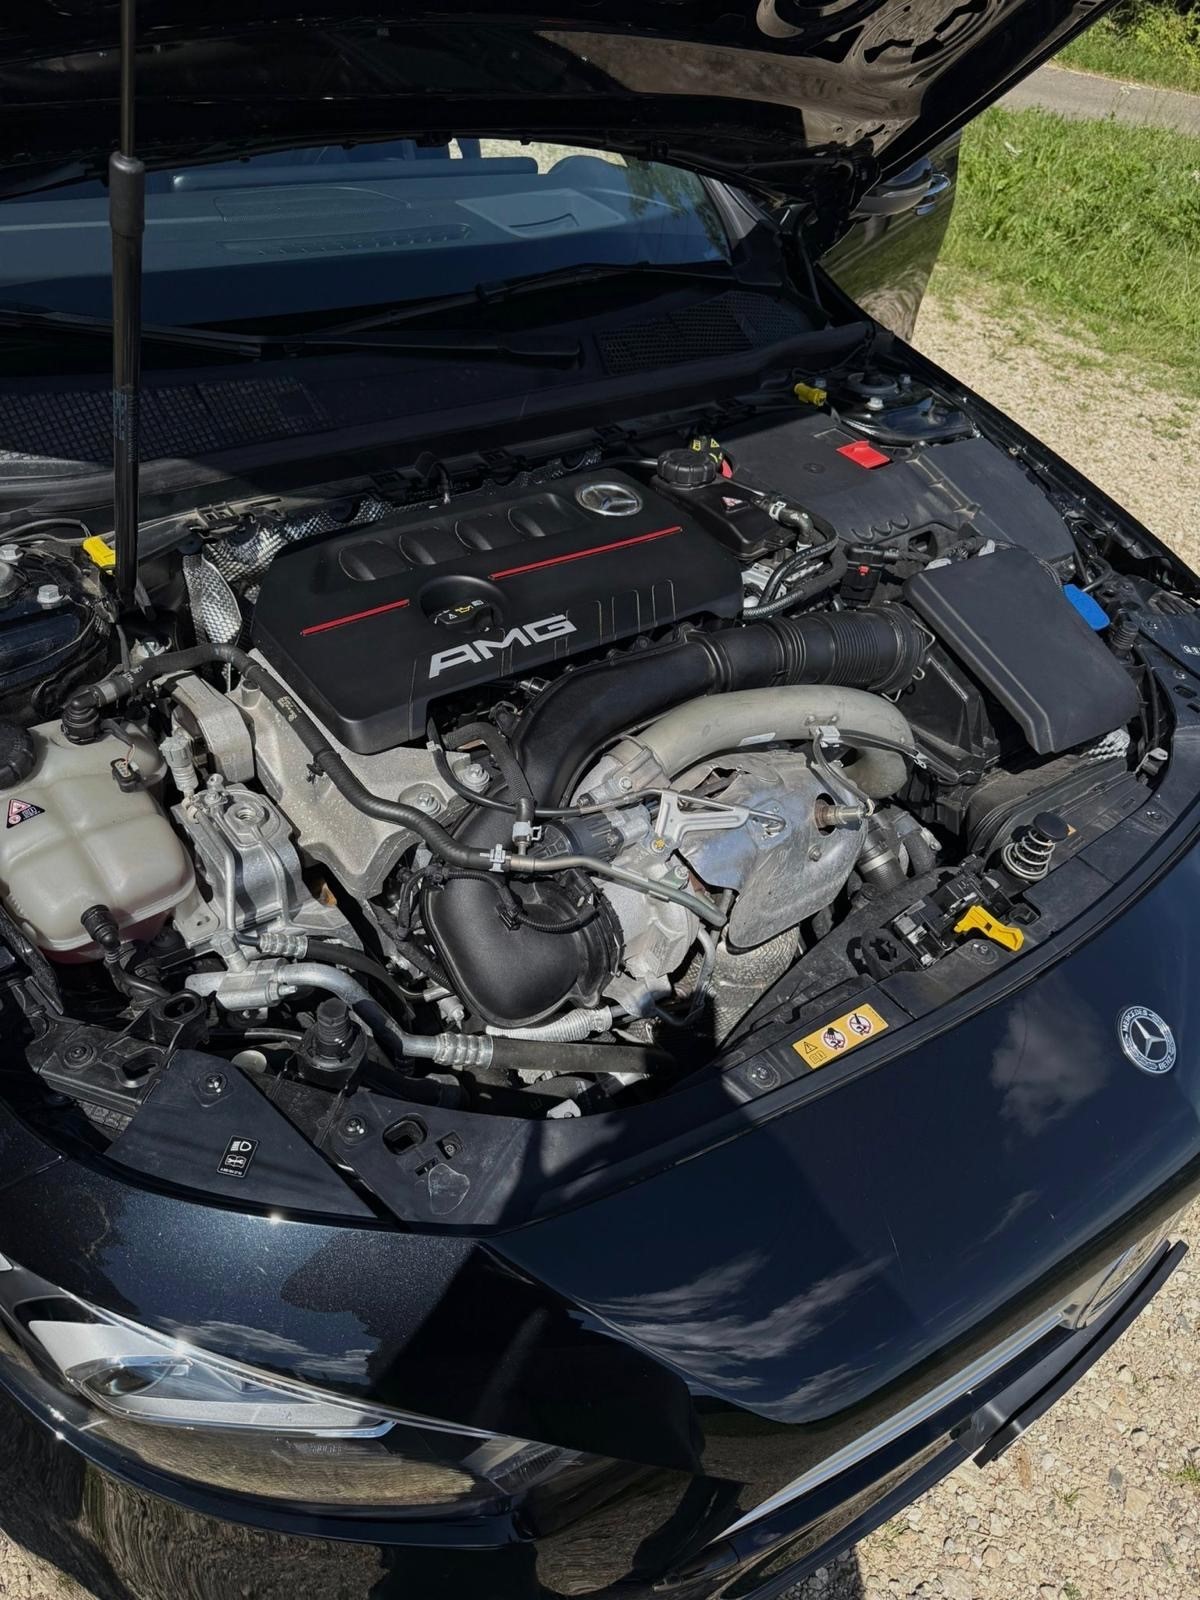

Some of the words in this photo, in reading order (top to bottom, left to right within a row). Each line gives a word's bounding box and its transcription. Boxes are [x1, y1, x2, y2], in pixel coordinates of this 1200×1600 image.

[429, 614, 577, 678] AMG
[1122, 1008, 1148, 1032] MERCEDES
[1158, 1055, 1173, 1070] BENZ
